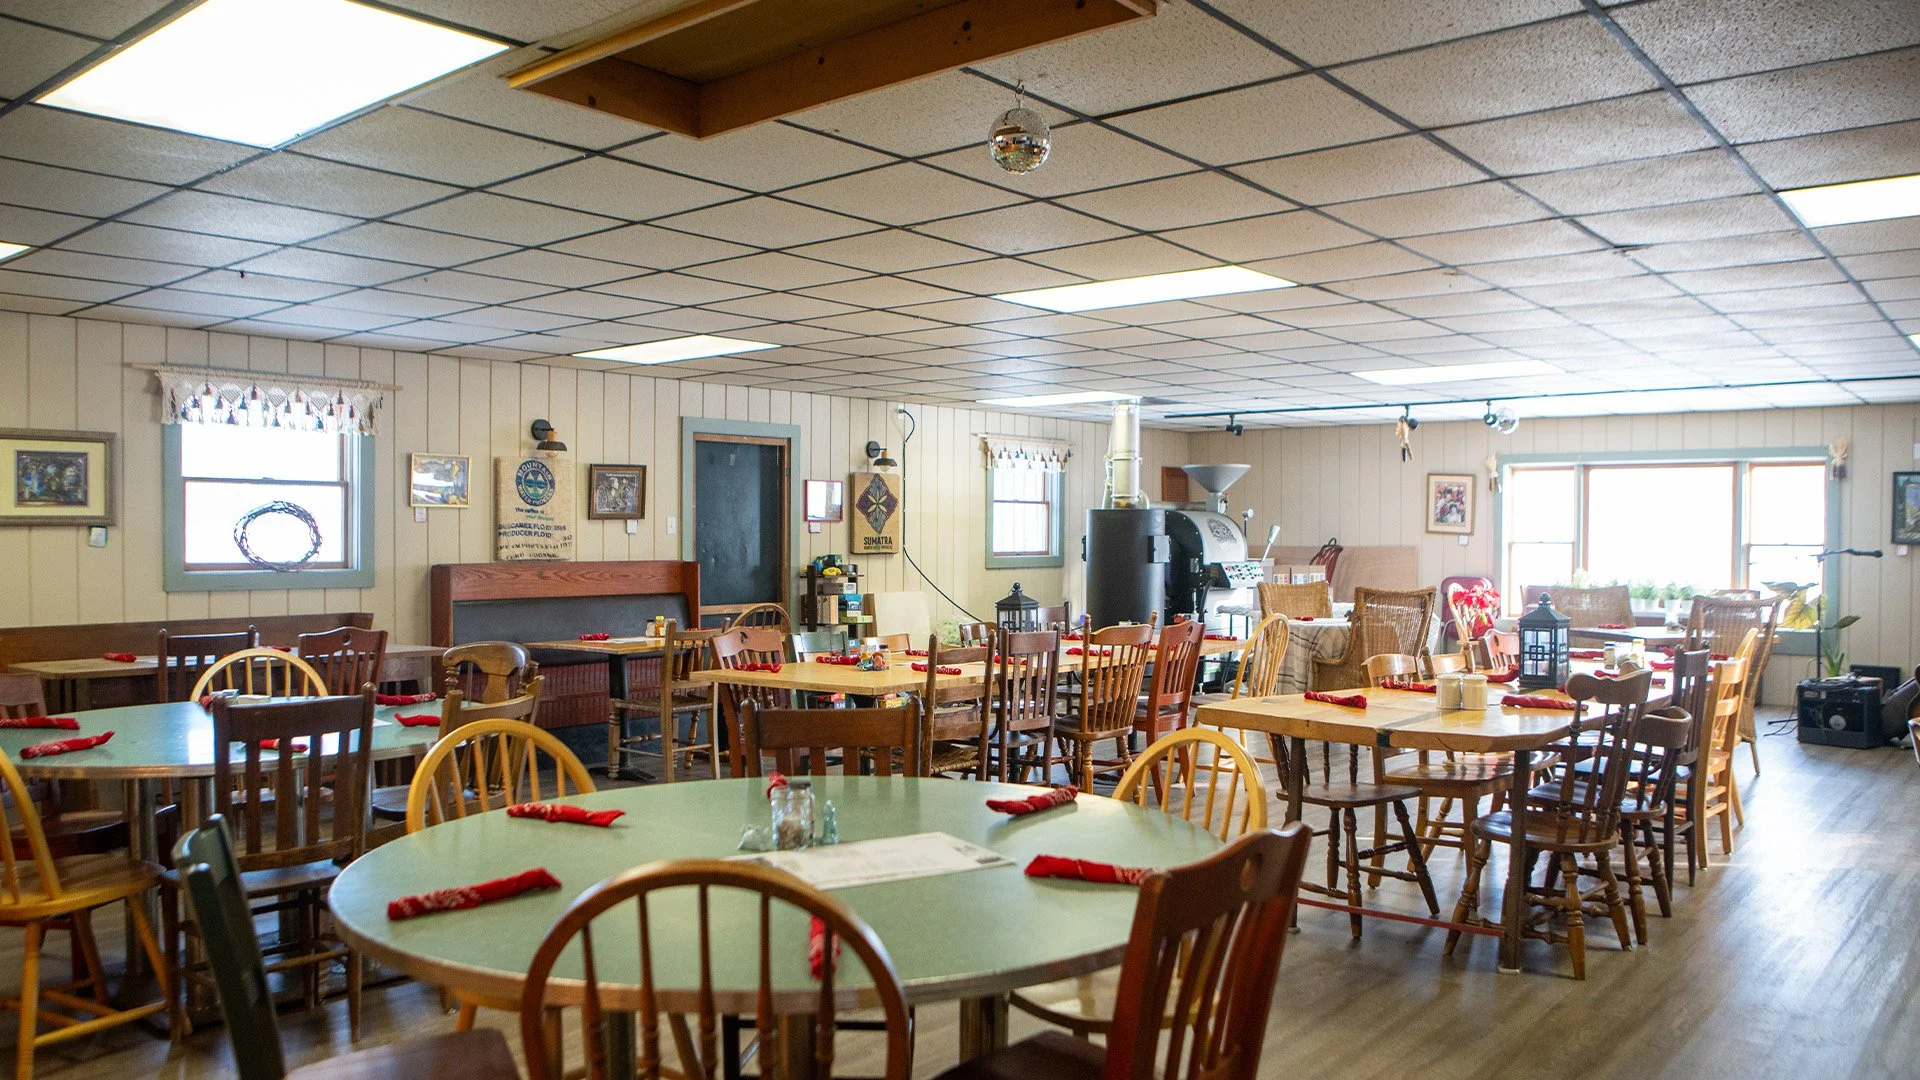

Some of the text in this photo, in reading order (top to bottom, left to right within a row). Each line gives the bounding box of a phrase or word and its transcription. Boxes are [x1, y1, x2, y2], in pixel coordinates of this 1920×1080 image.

[518, 461, 553, 481] MOUNTAIN
[518, 484, 554, 505] WATER PROCESS
[864, 536, 892, 545] SUMATRA
